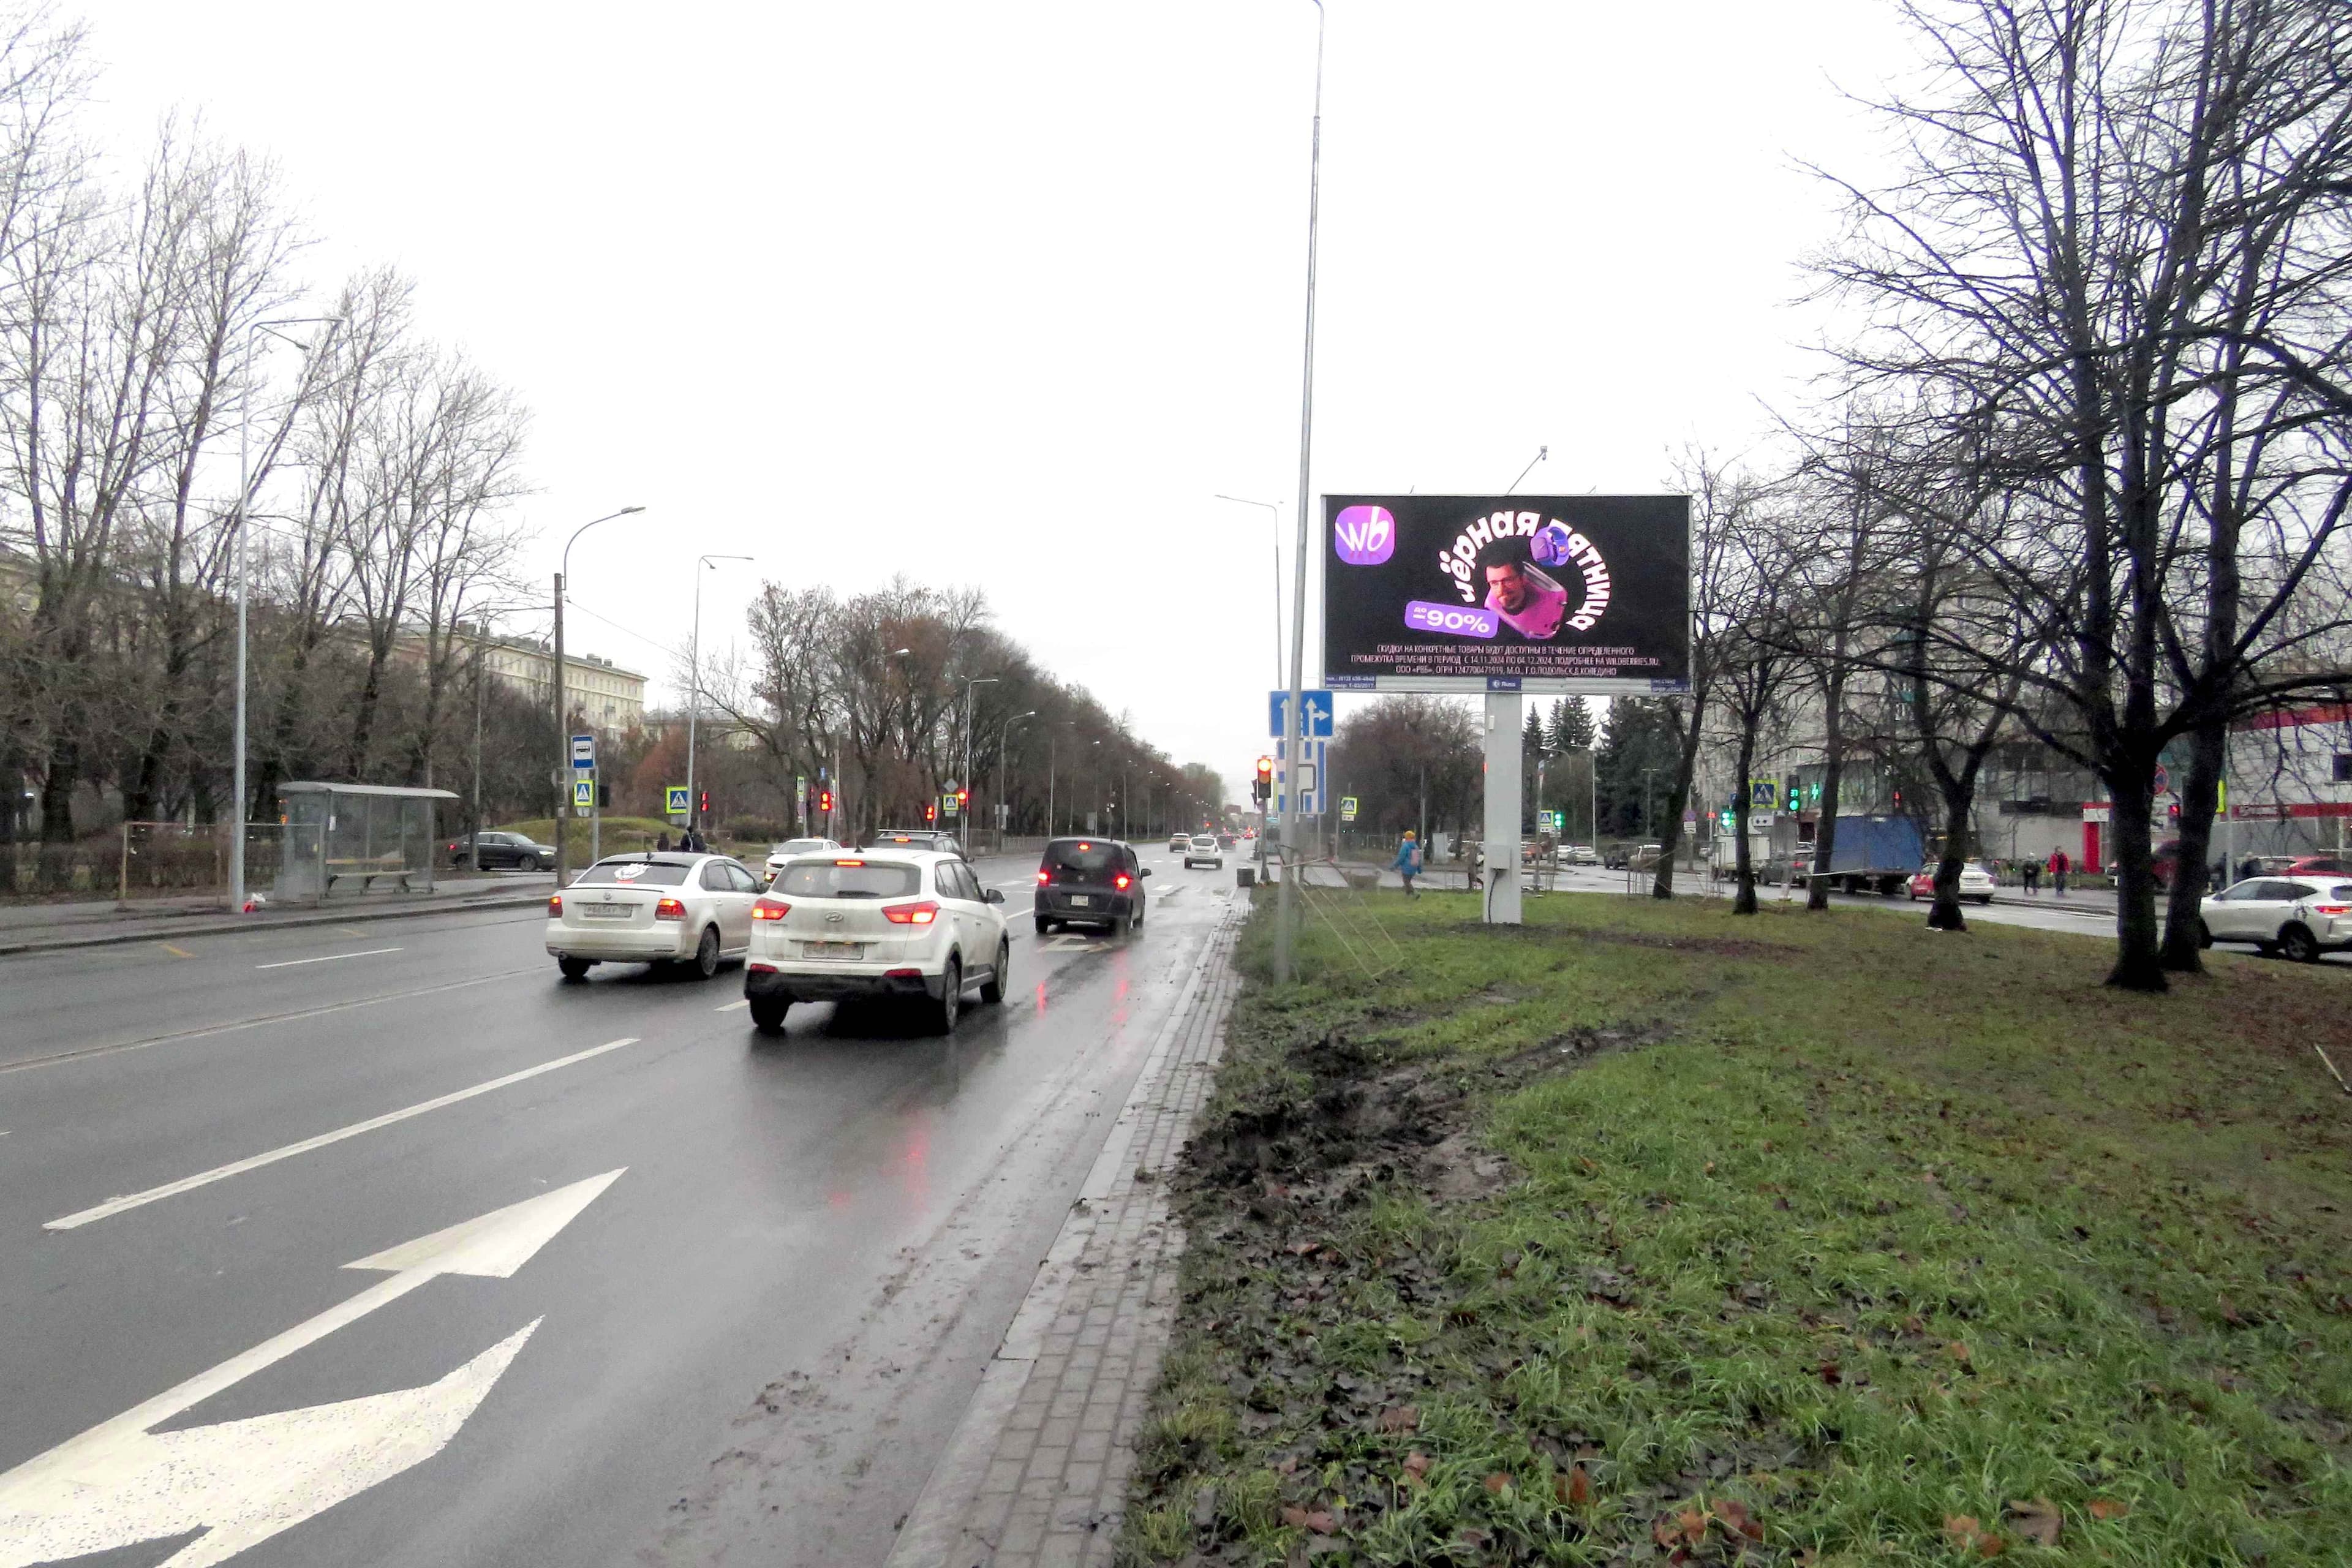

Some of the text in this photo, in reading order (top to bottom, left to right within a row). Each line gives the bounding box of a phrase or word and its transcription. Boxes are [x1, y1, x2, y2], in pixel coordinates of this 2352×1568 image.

[1377, 645, 1403, 654] СКИДКИ
[1485, 646, 1503, 655] БУДУТ
[1504, 646, 1540, 655] ДОСТУПНЫ
[1434, 656, 1461, 665] ПЕРИОД
[1555, 657, 1594, 666] ПОДРОБНЕЕ
